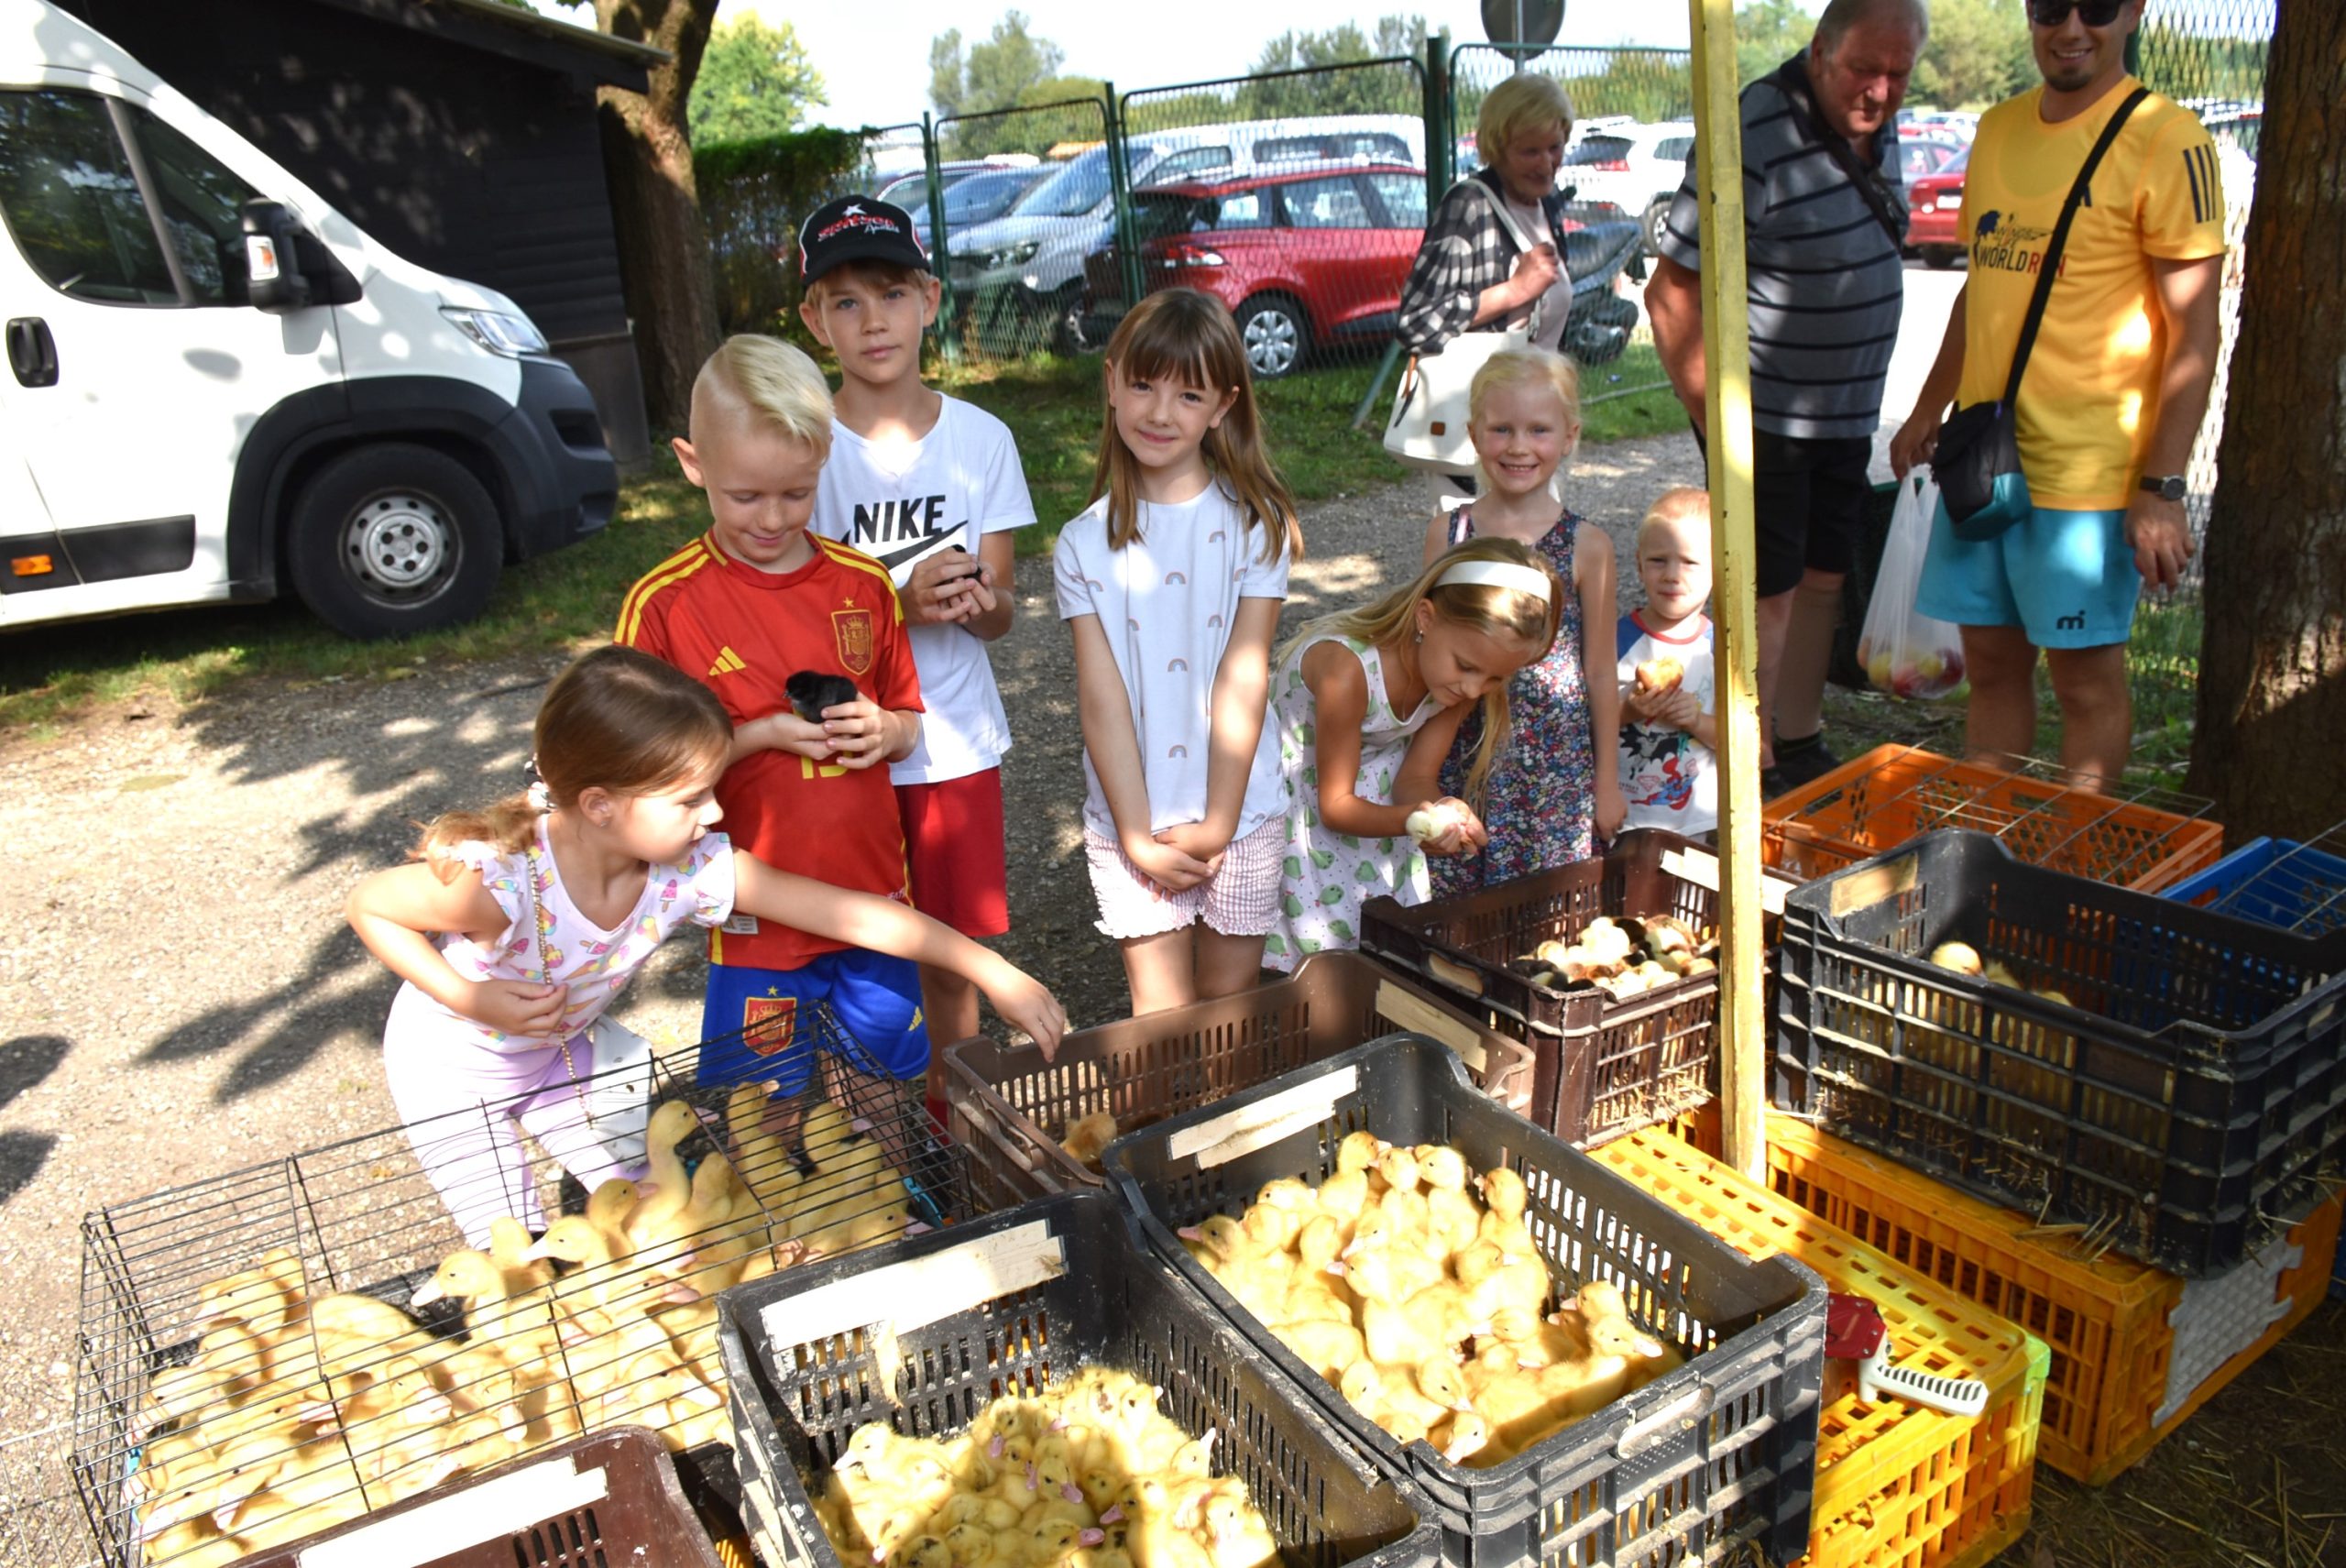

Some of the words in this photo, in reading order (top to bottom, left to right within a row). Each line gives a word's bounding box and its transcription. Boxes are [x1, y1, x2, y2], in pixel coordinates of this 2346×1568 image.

[1979, 246, 2028, 271] WORLD
[2027, 252, 2068, 277] RN
[853, 495, 946, 543] NIKE
